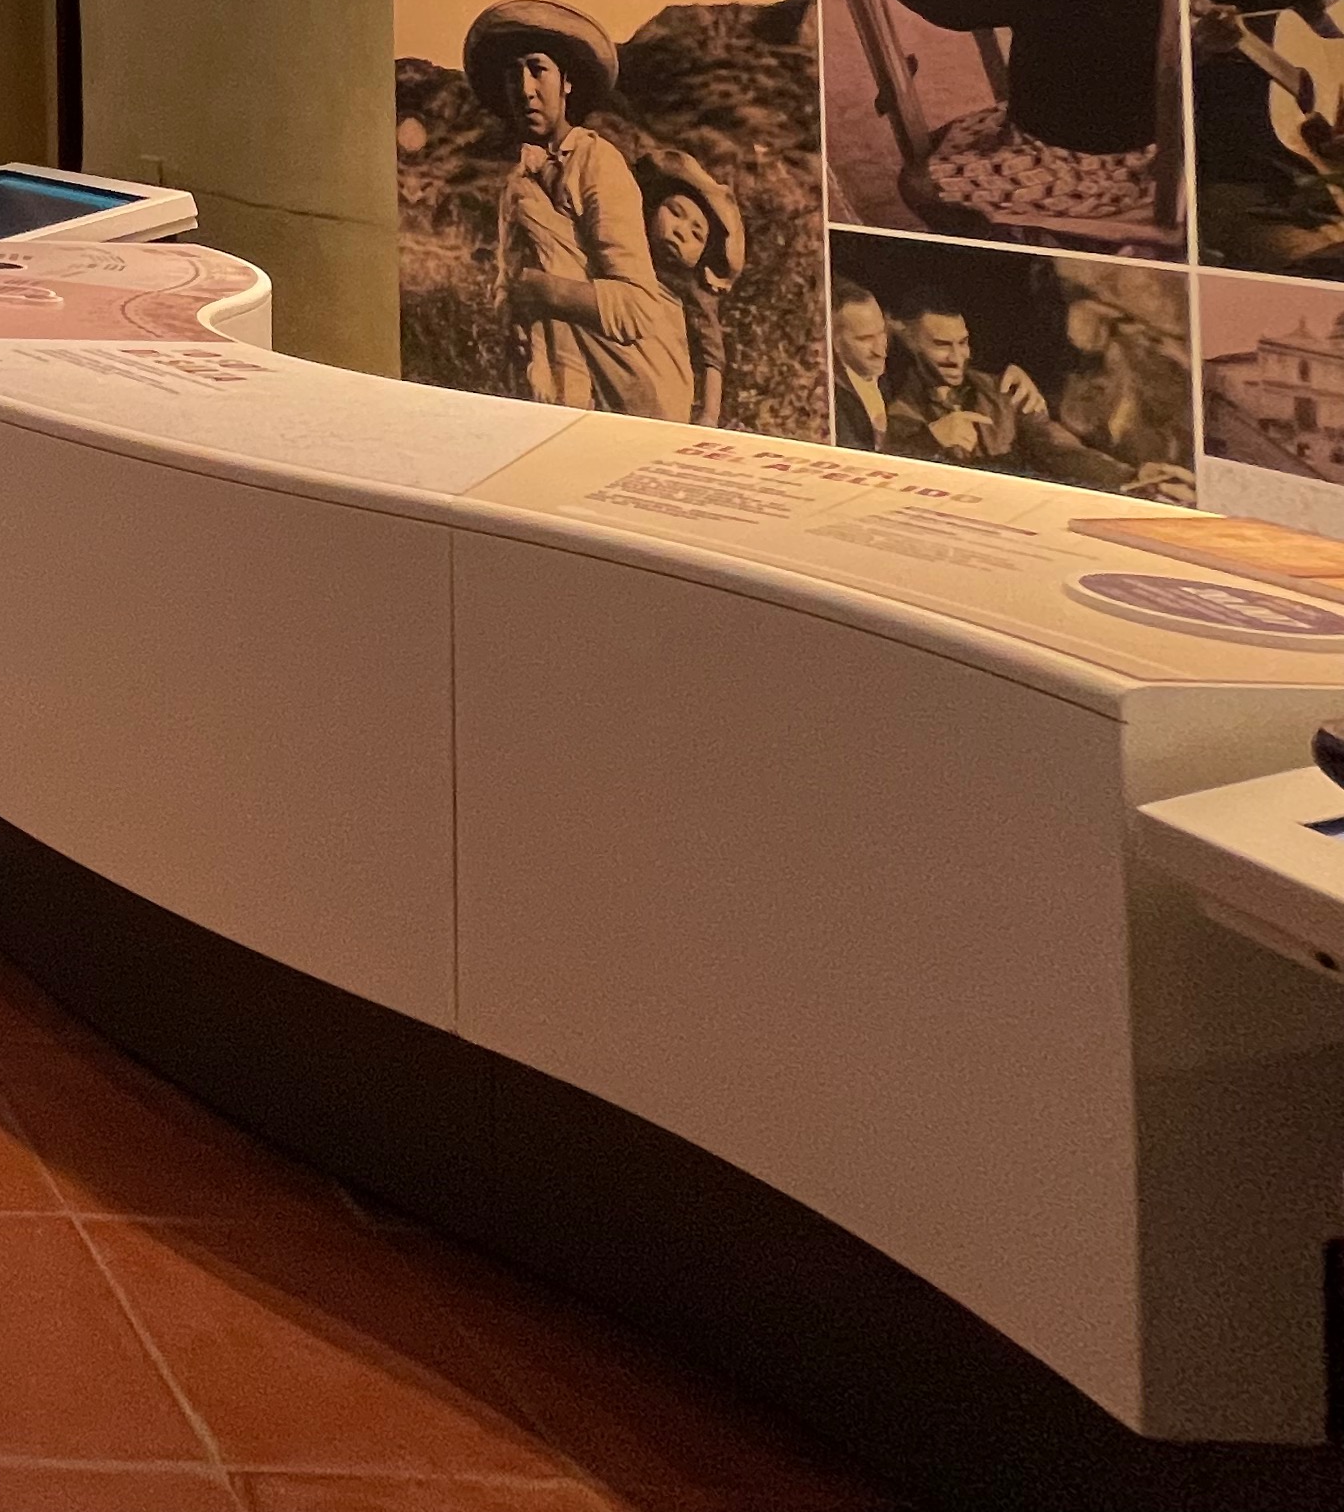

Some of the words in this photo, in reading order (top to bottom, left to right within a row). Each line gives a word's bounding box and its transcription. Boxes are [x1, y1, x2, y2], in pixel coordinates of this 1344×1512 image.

[693, 441, 736, 454] EL
[752, 452, 899, 480] PODER
[761, 463, 983, 504] APELLIDO
